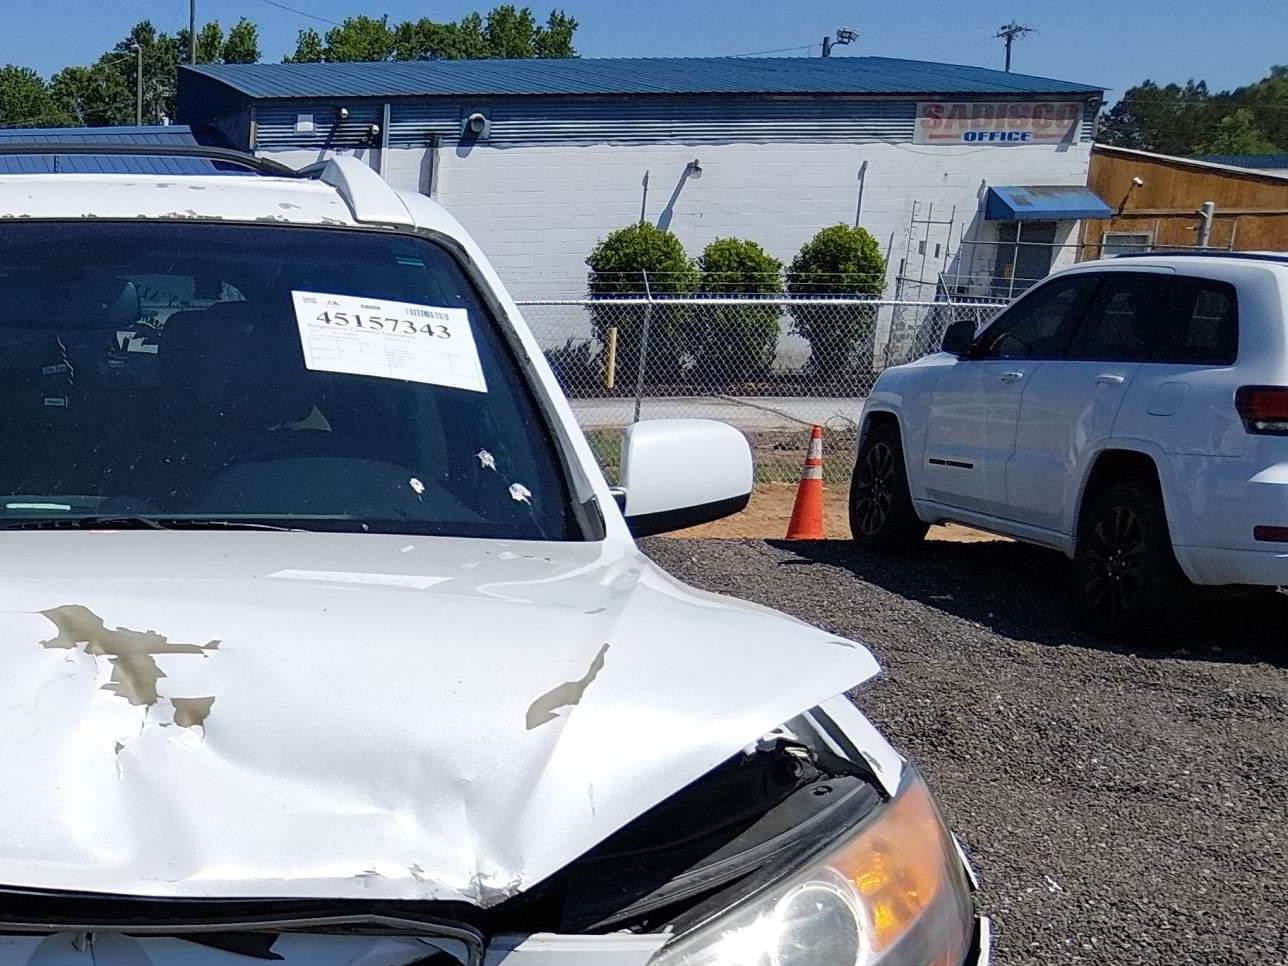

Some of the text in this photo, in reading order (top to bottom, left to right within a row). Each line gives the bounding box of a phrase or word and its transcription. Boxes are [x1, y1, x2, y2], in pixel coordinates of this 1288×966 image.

[919, 103, 1080, 129] SADISCO
[963, 131, 1033, 142] OFFICE
[316, 311, 452, 340] 45157343
